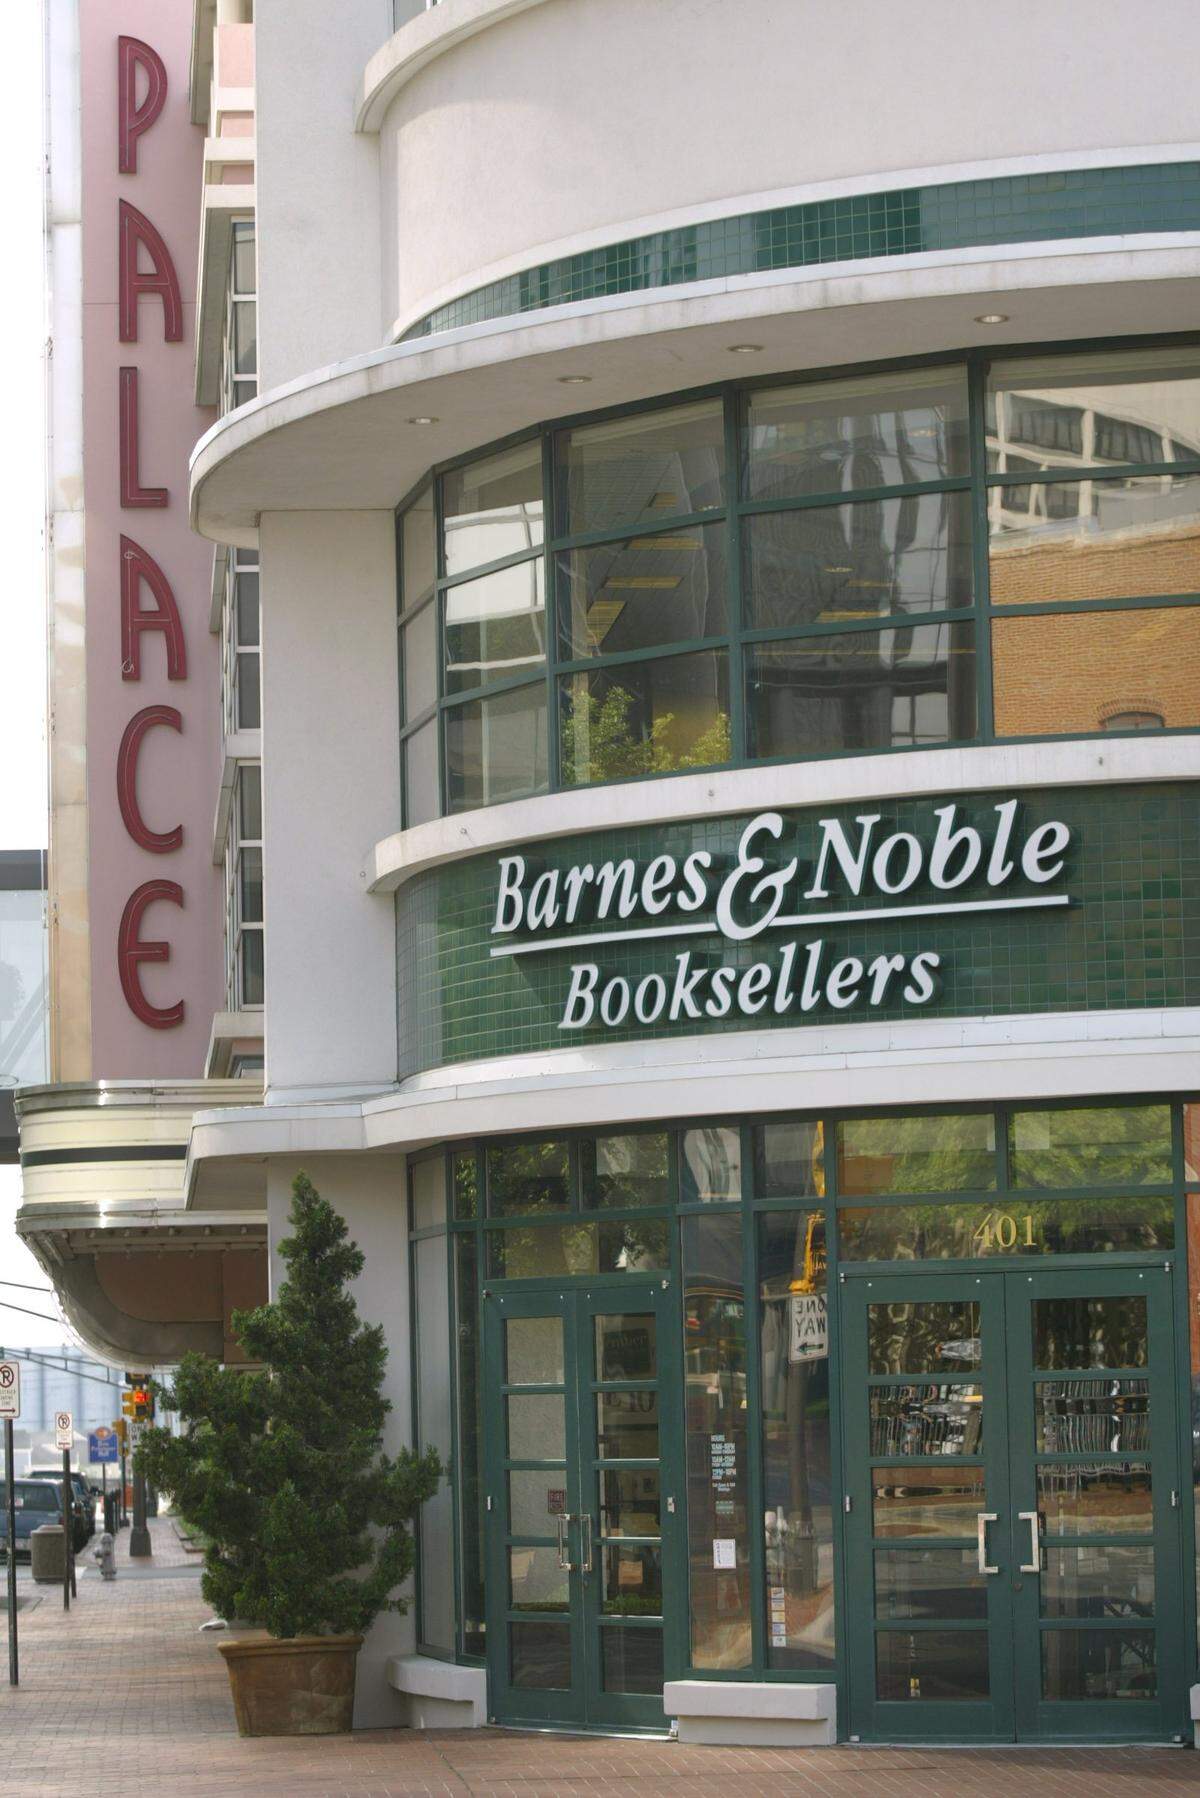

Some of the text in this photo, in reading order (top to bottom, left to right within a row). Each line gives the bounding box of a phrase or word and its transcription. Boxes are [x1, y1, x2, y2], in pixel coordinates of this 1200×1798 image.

[117, 34, 187, 1030] PALACE
[491, 798, 1071, 940] Barnes & Noble
[557, 938, 940, 1030] Booksellers
[973, 1213, 1037, 1248] 401
